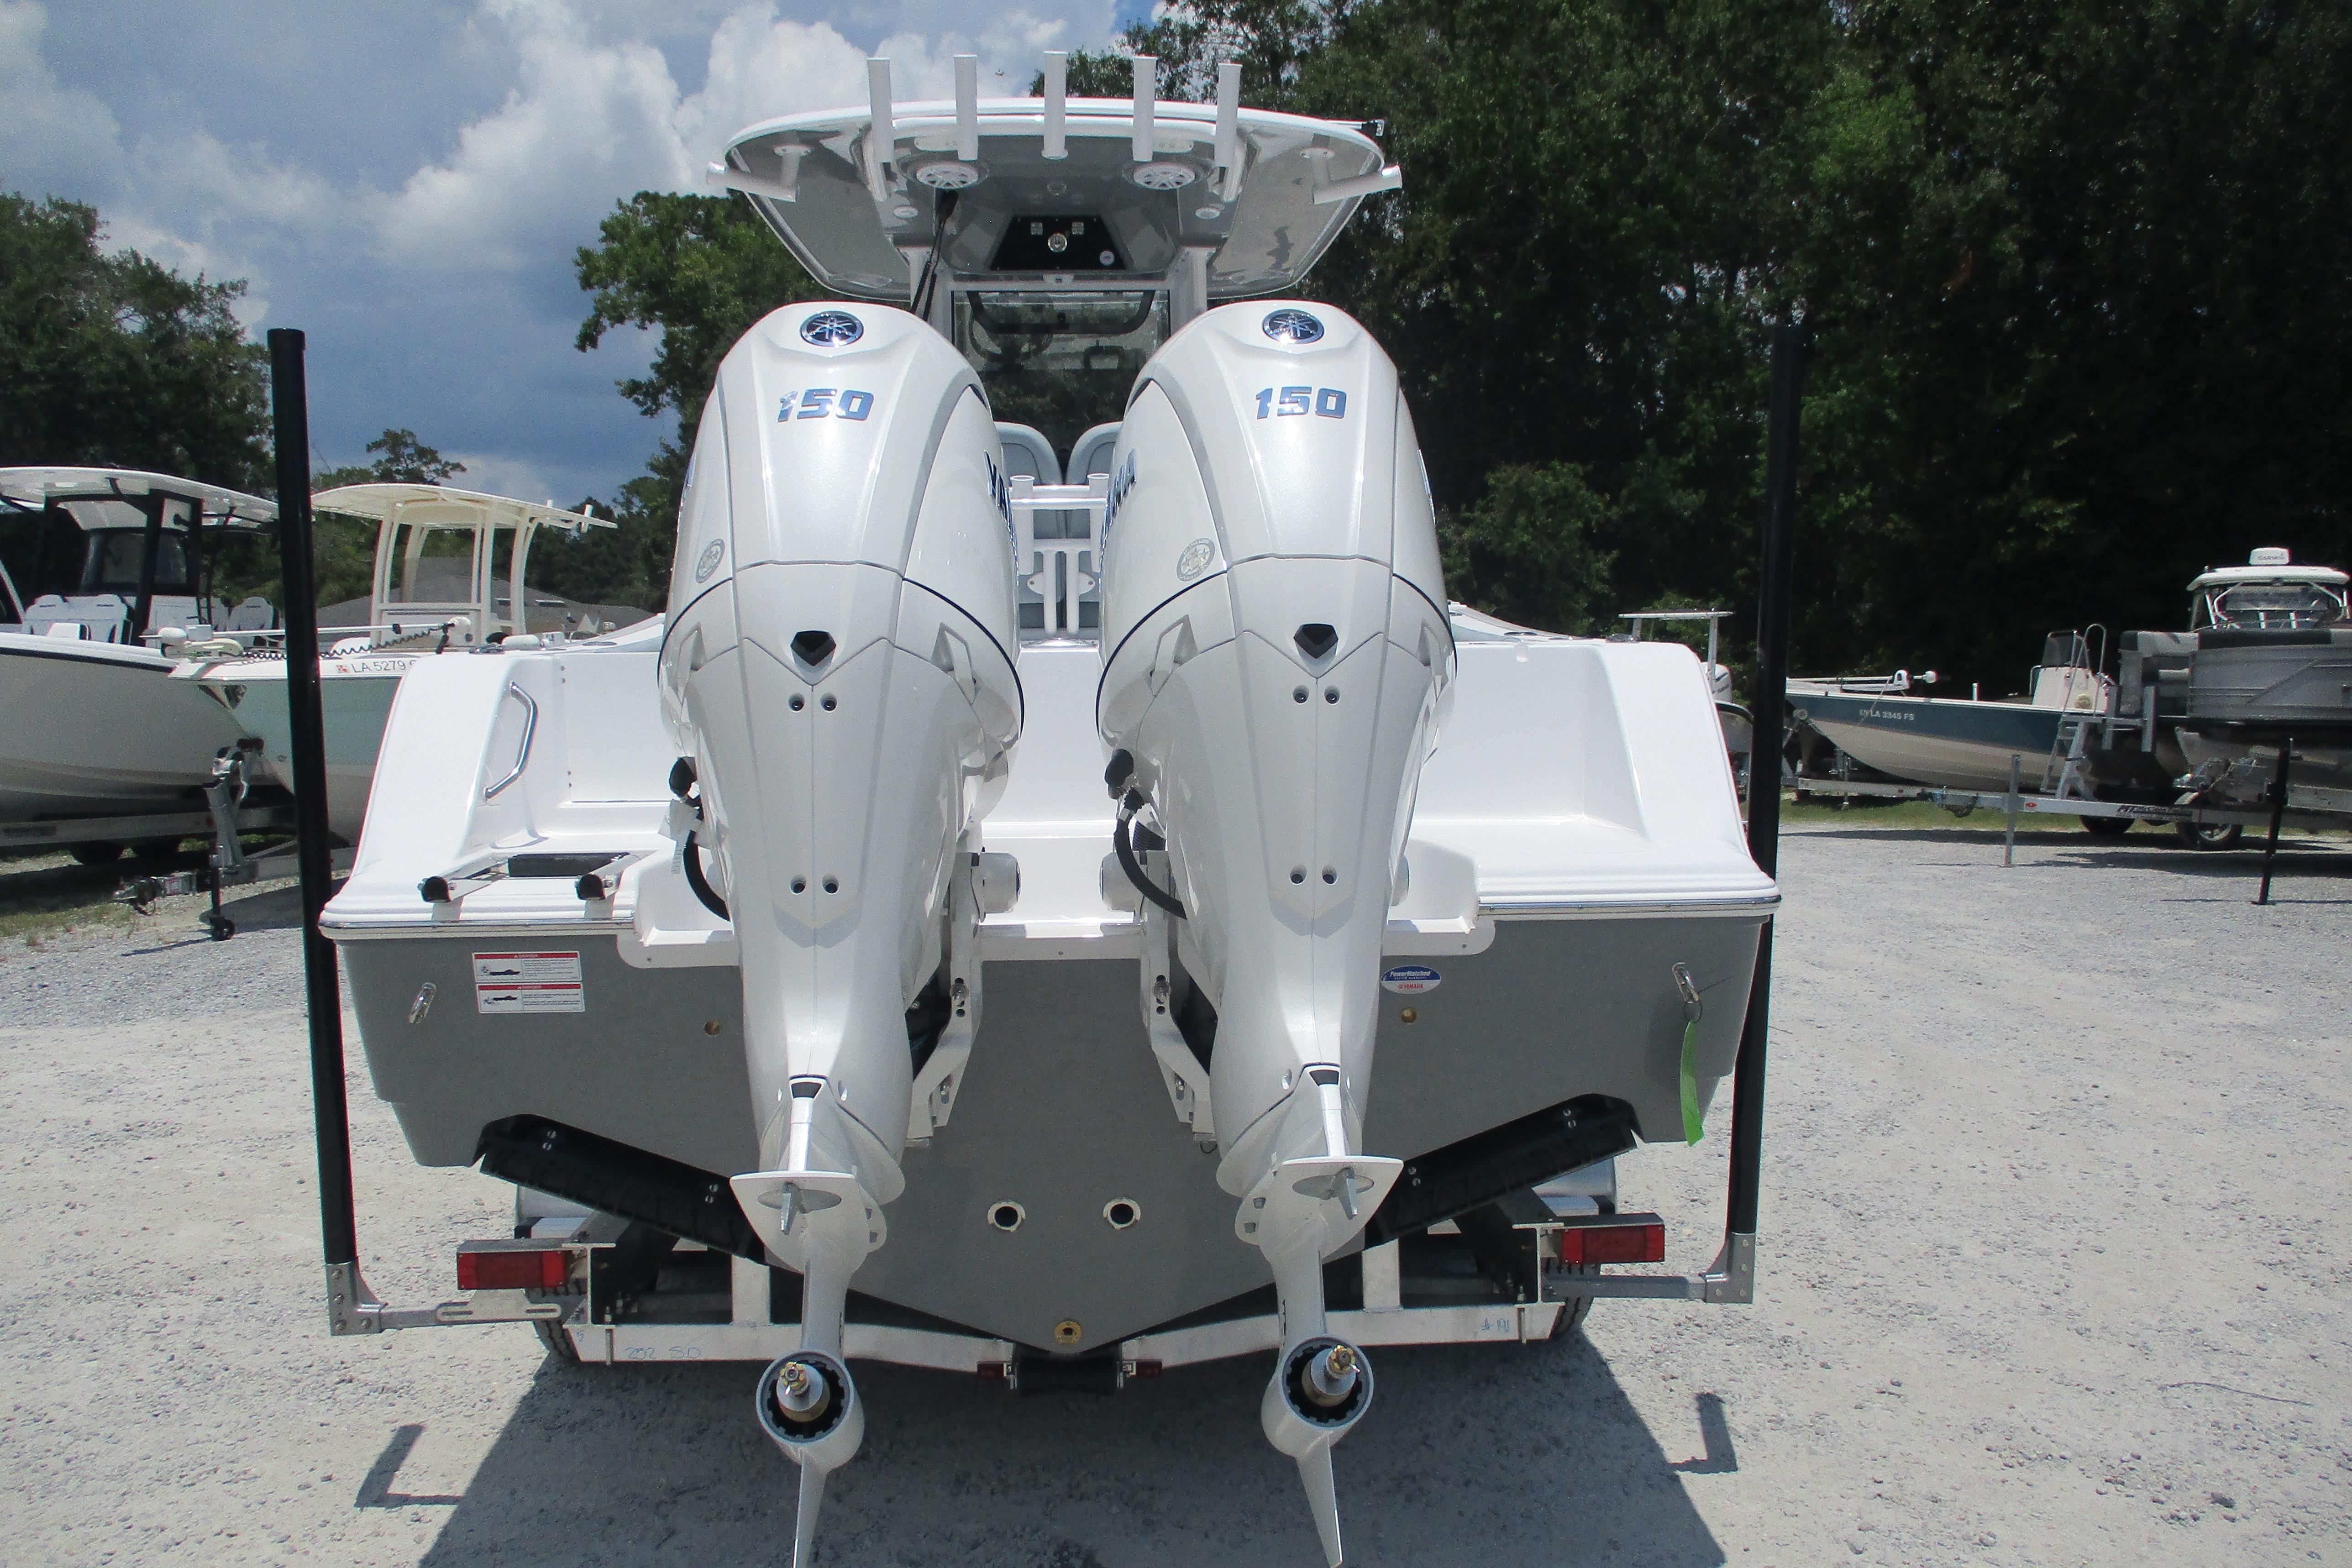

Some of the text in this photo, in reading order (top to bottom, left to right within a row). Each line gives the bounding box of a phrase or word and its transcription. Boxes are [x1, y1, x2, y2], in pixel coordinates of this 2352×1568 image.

[777, 387, 875, 423] 150
[1255, 384, 1348, 420] 150
[351, 662, 371, 672] LA
[373, 660, 406, 671] 5279
